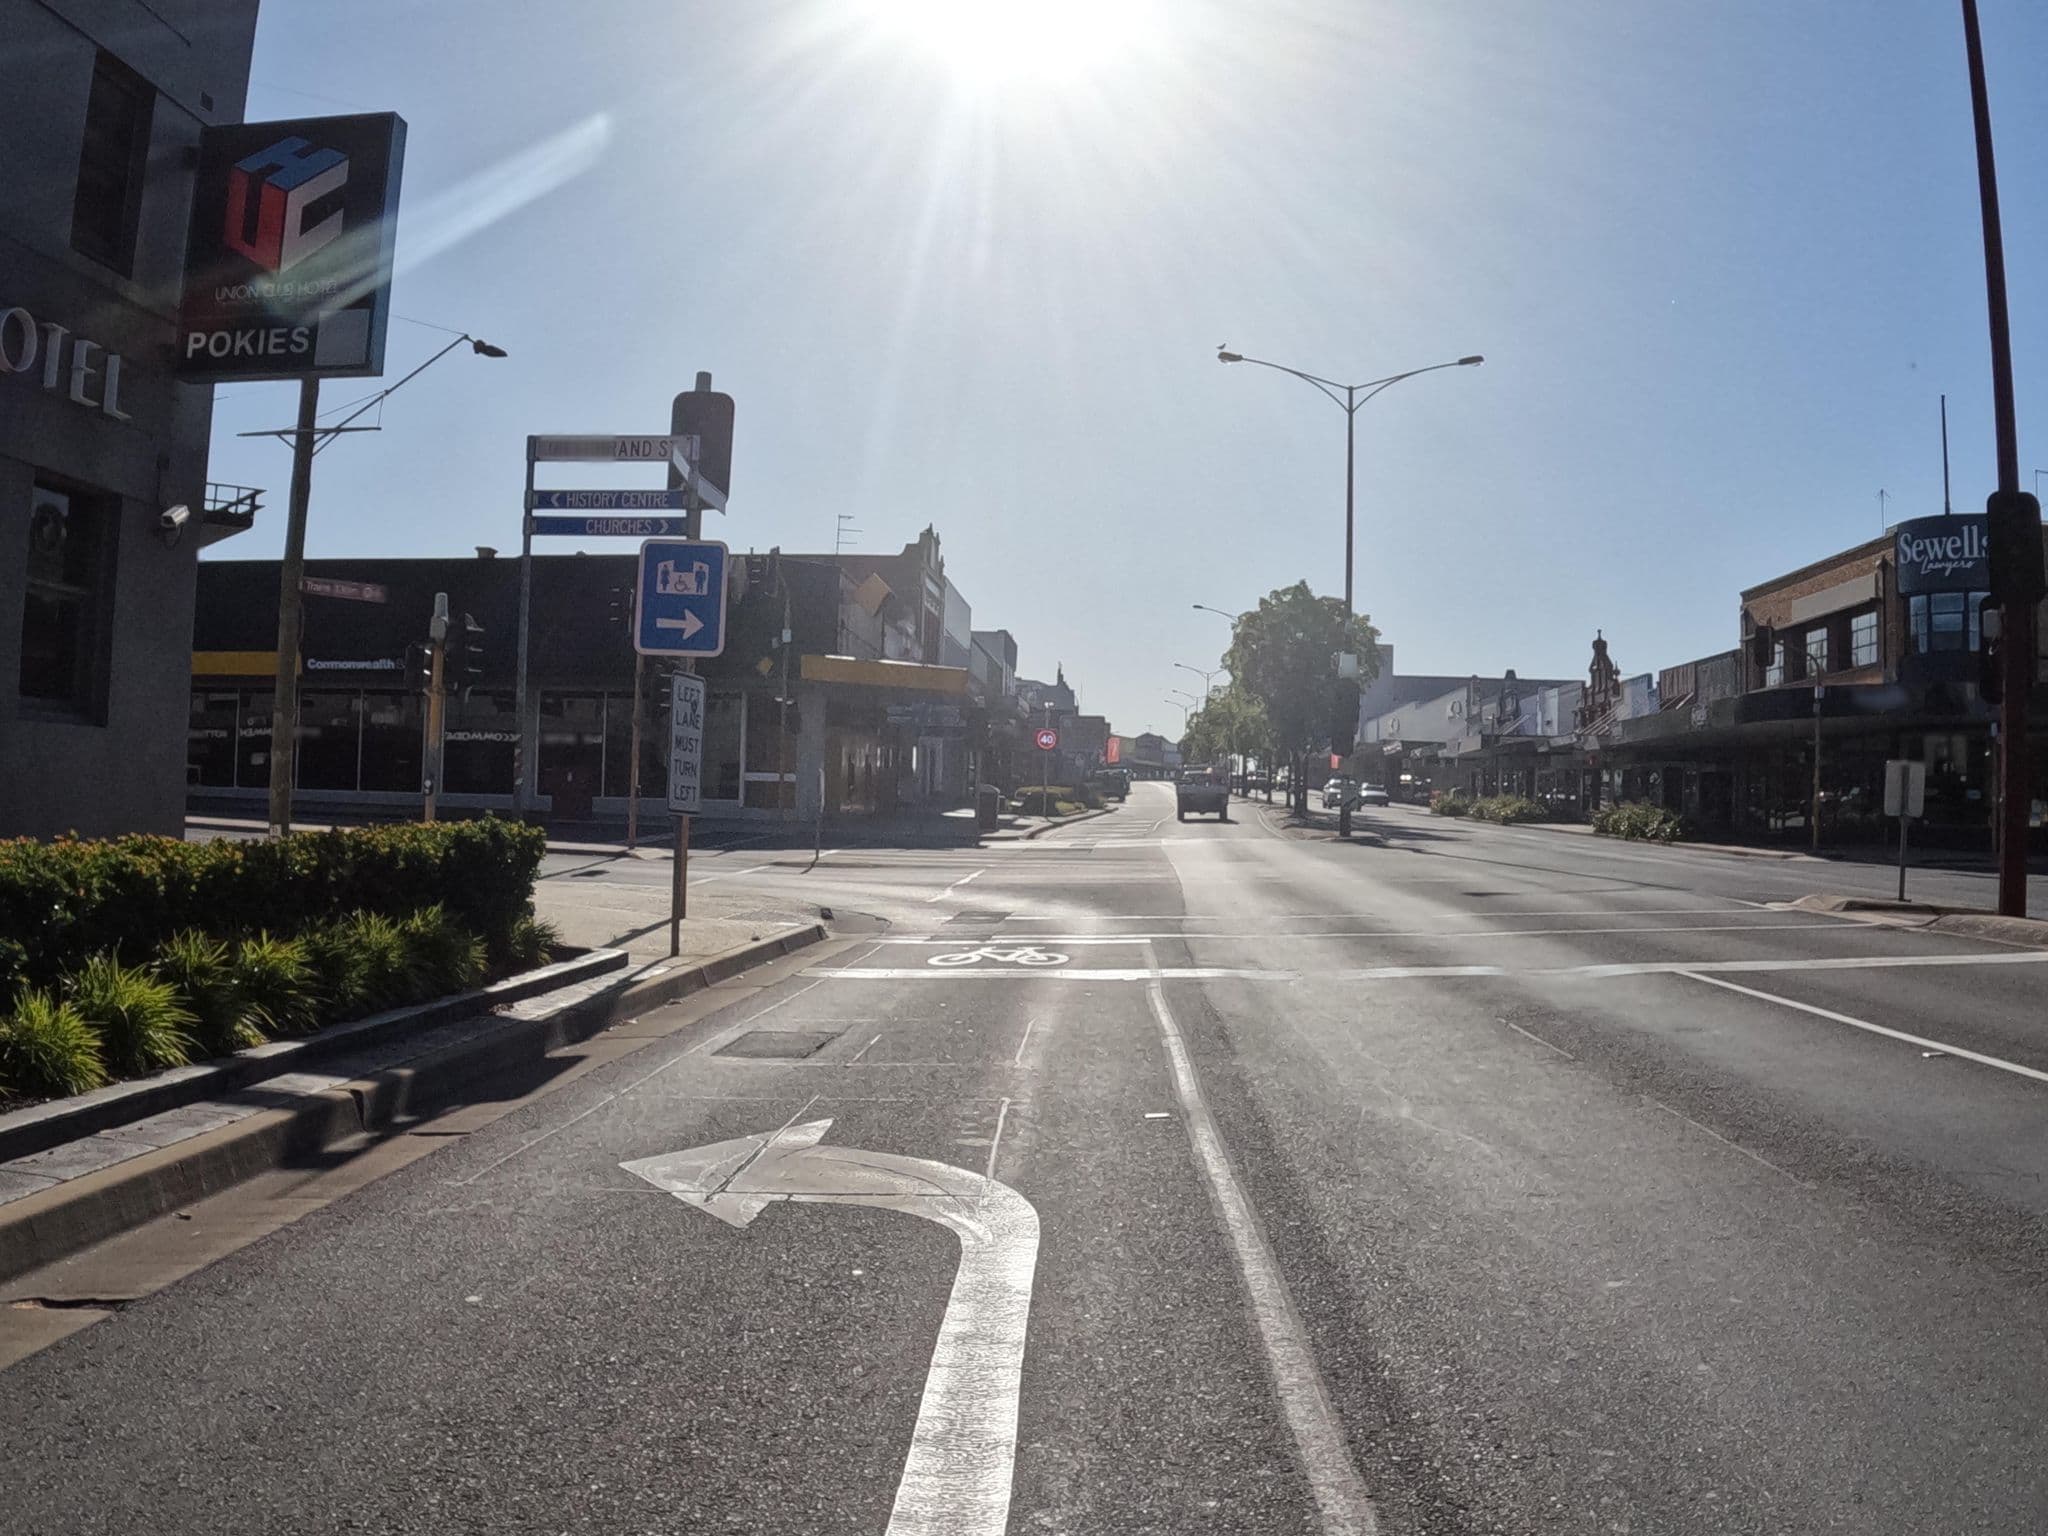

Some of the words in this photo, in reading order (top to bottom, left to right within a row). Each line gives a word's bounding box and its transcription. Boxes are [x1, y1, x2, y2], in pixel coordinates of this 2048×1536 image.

[186, 327, 310, 359] POKIES
[566, 492, 617, 508] HISTORY
[621, 492, 669, 507] CENTRE
[585, 519, 653, 534] CHURCHES
[1920, 556, 1976, 577] Lawyers
[306, 658, 395, 670] Commonwealth
[676, 684, 702, 704] LEFT
[675, 710, 702, 731] LANE
[674, 735, 699, 754] MUST
[1040, 735, 1054, 744] 40
[673, 759, 698, 778] TURN
[673, 783, 697, 802] LEFT
